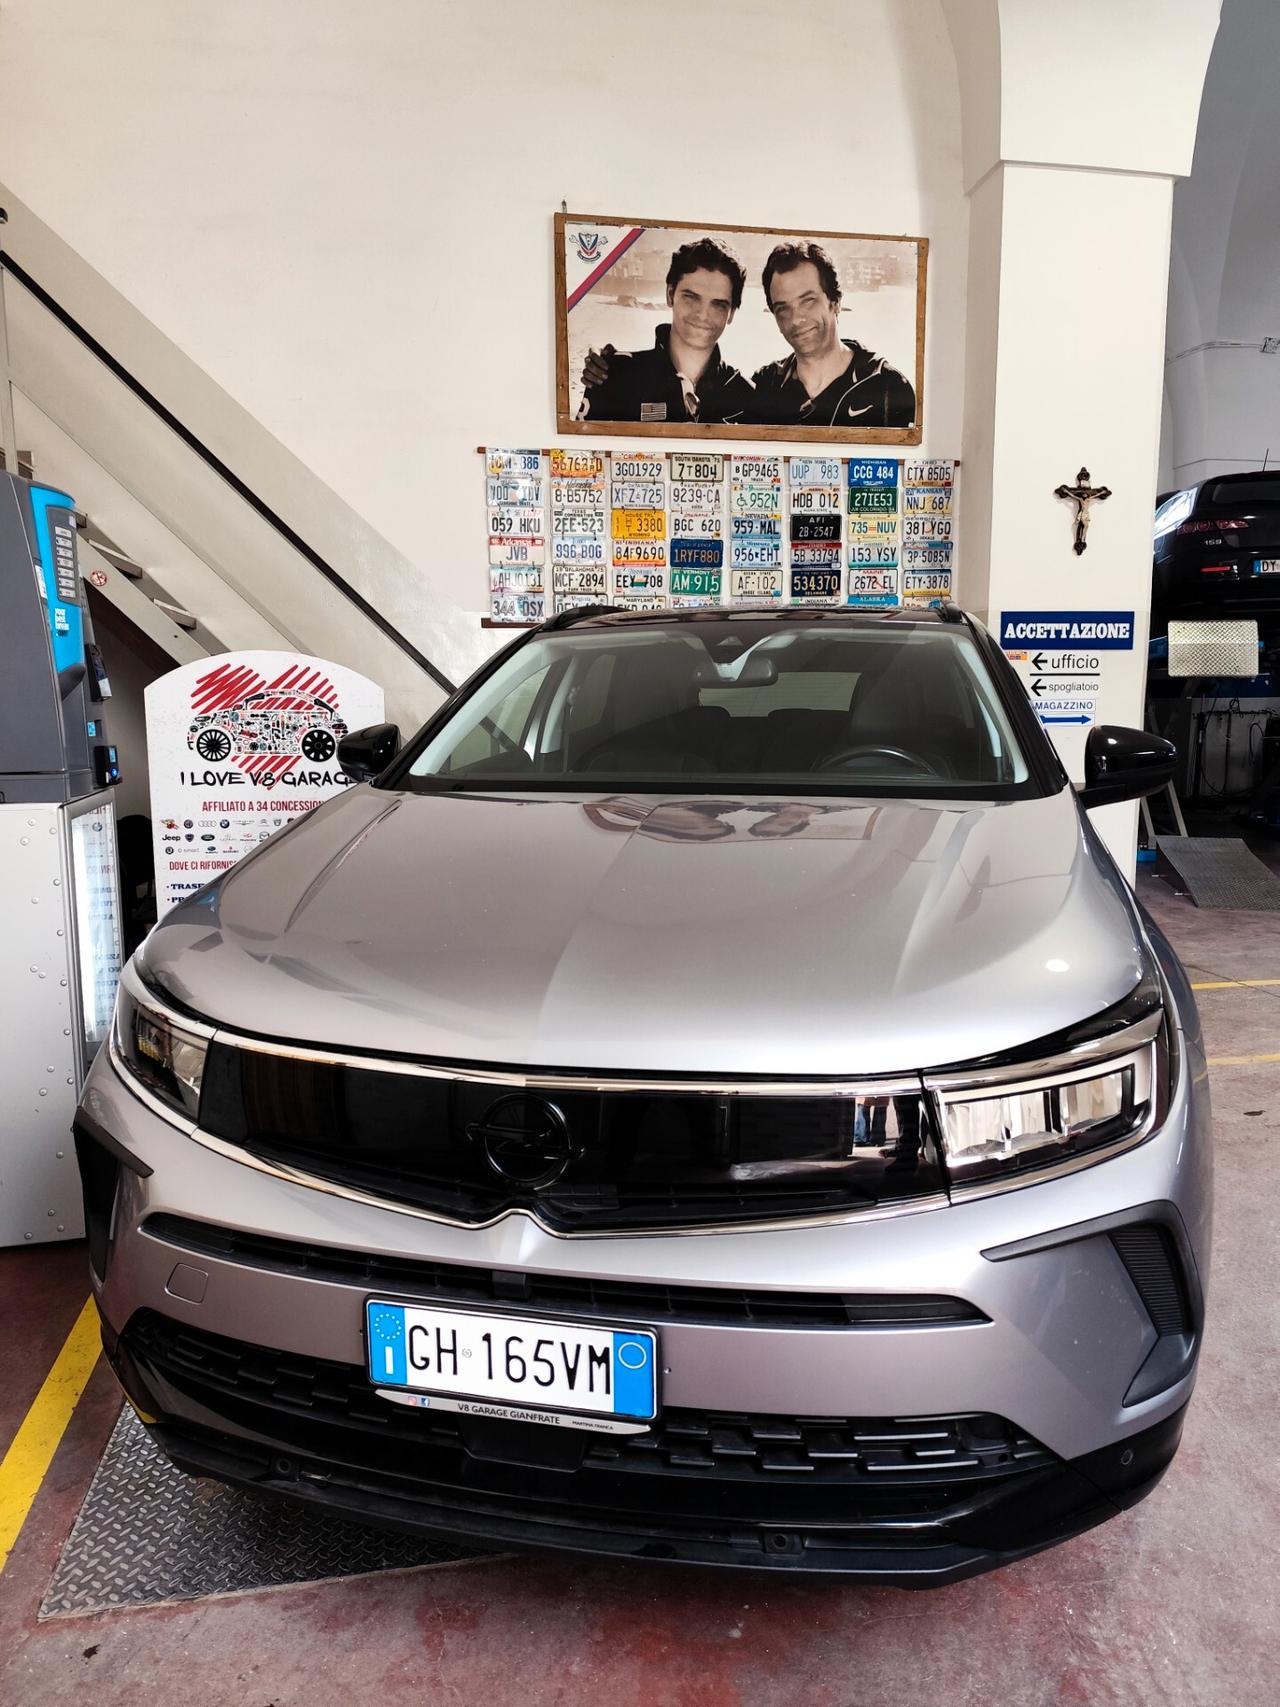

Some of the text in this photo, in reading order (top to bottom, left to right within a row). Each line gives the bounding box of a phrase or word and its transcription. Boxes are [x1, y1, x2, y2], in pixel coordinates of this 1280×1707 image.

[615, 463, 662, 477] 3G01929
[742, 464, 779, 478] GP9465
[821, 465, 839, 479] 983
[854, 465, 894, 479] CCG 484
[907, 467, 951, 481] CTX 8505
[750, 493, 779, 508] 952N
[793, 493, 839, 508] HDB 012
[906, 497, 951, 510] NNJ 687
[491, 517, 513, 532] 059
[637, 518, 662, 532] 3380
[674, 519, 721, 532] BGC 620
[851, 522, 896, 533] 735 NUV
[906, 522, 925, 535] 381
[555, 544, 577, 559] 996
[674, 549, 720, 563] 1RYF880
[734, 548, 780, 562] 956 EHT
[852, 548, 896, 562] 153 YSY
[794, 576, 838, 591] 534370
[1004, 623, 1130, 639] ACCETTAZIONE
[1051, 654, 1099, 669] ufficio
[1048, 681, 1099, 693] spogliatoio
[1034, 701, 1093, 710] MAGAZZINO
[181, 772, 185, 786] I
[191, 771, 245, 786] LOVE
[250, 771, 276, 787] V8
[202, 801, 246, 812] AFFILIATO
[248, 801, 254, 811] A
[257, 801, 268, 811] 34
[162, 834, 181, 842] Jeep
[169, 861, 189, 870] DOVE
[191, 861, 198, 870] CI
[408, 1325, 458, 1376] GH
[482, 1332, 611, 1395] 165VM
[458, 1403, 470, 1412] V8
[472, 1405, 508, 1418] GARAGE
[510, 1411, 560, 1424] GIANFRATE
